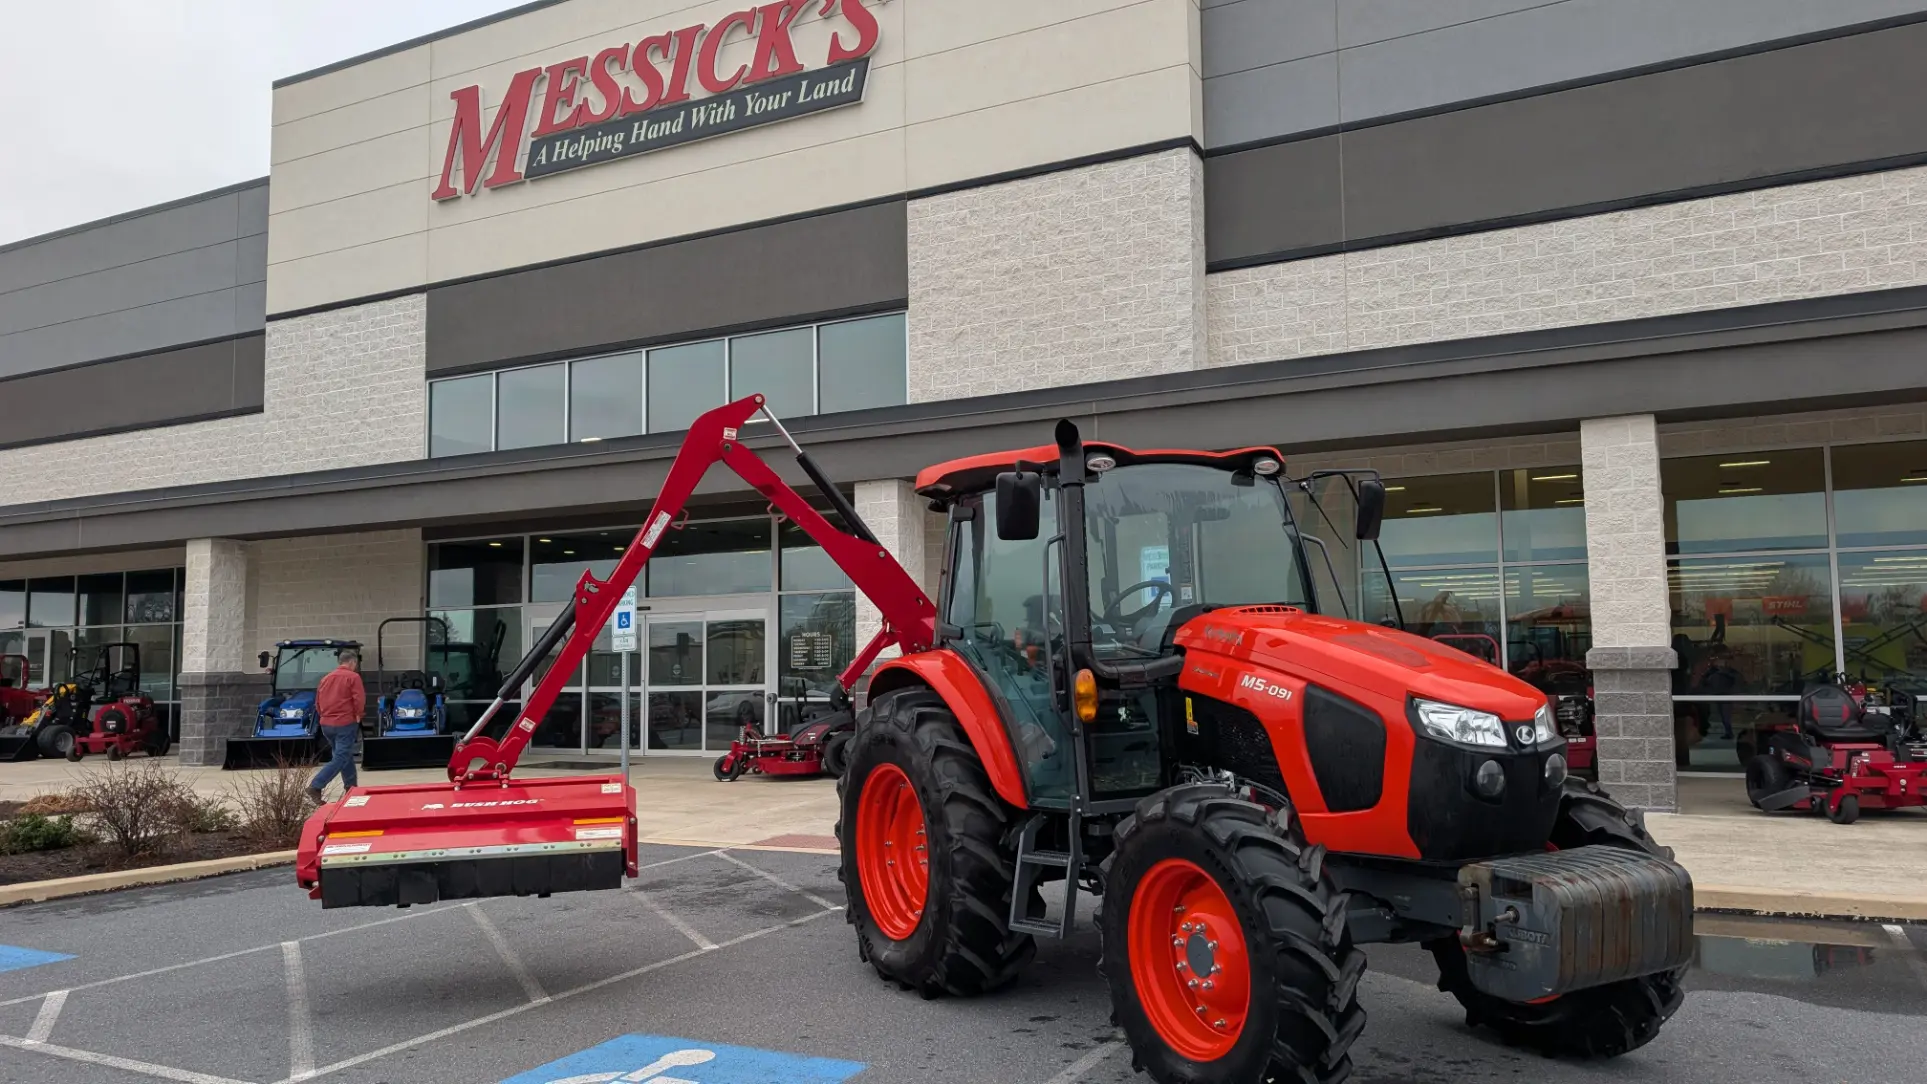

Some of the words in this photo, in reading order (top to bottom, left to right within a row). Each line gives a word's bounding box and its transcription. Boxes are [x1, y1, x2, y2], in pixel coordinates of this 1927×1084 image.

[432, 0, 879, 200] MESSICK'S
[532, 145, 547, 166] A
[552, 130, 625, 160] Helping
[630, 110, 684, 143] Hand
[690, 99, 736, 129] With
[744, 90, 792, 113] Your
[797, 69, 855, 104] Land
[1768, 600, 1803, 609] STIHL
[1241, 674, 1293, 700] M5-091
